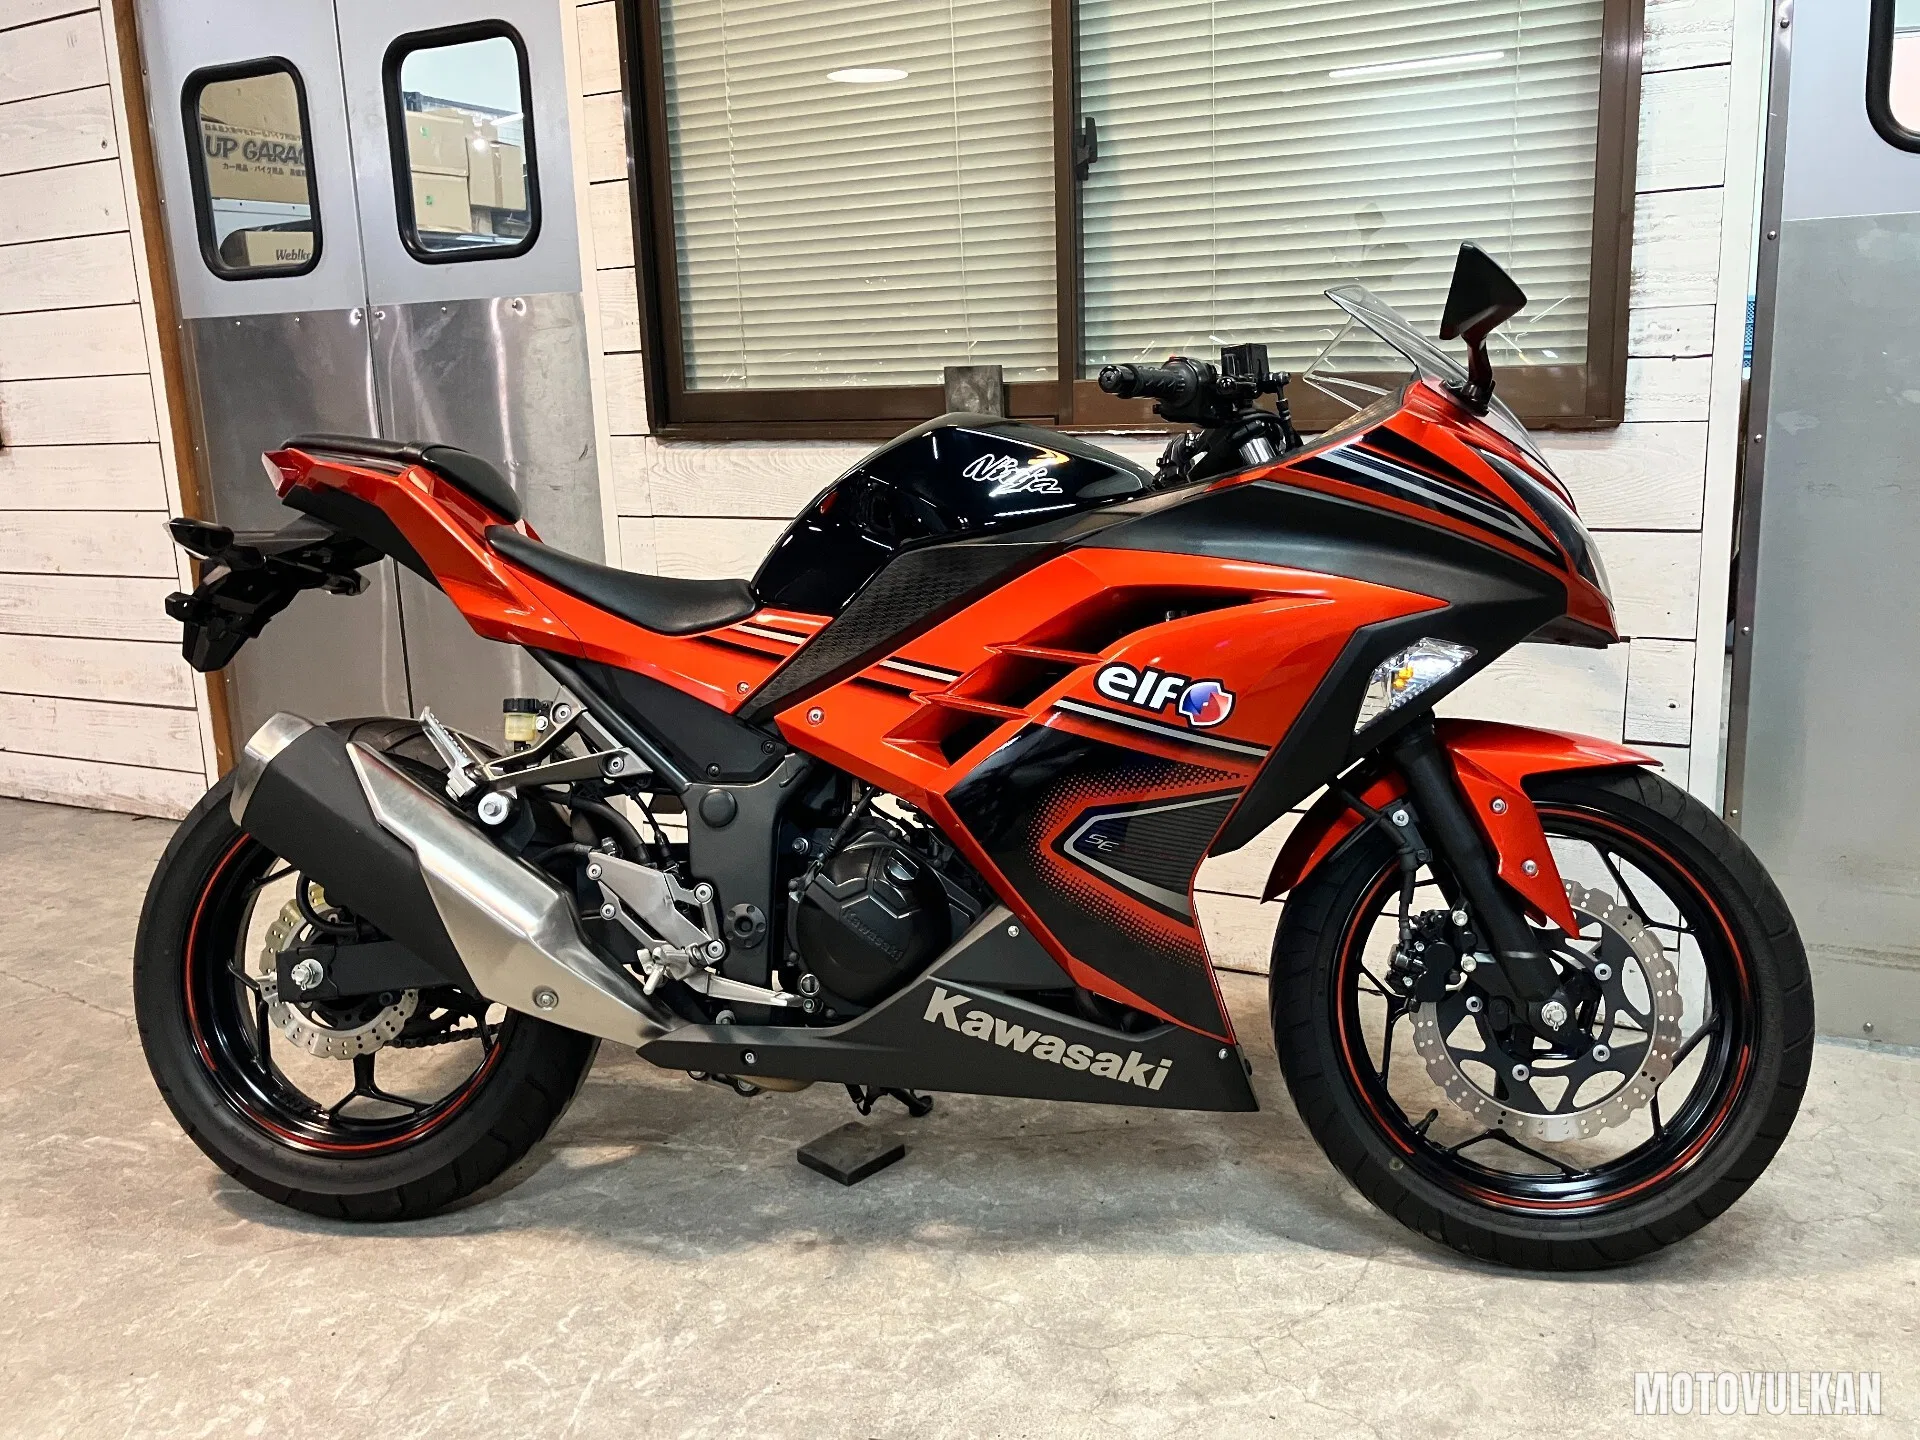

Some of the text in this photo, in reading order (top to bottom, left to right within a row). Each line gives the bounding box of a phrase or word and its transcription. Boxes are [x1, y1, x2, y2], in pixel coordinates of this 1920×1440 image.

[205, 135, 238, 158] UP
[962, 453, 1064, 498] Ninja
[1097, 665, 1185, 710] elf
[1084, 833, 1120, 852] SE
[841, 906, 904, 961] Kawasaki
[923, 986, 1173, 1091] Kawasaki
